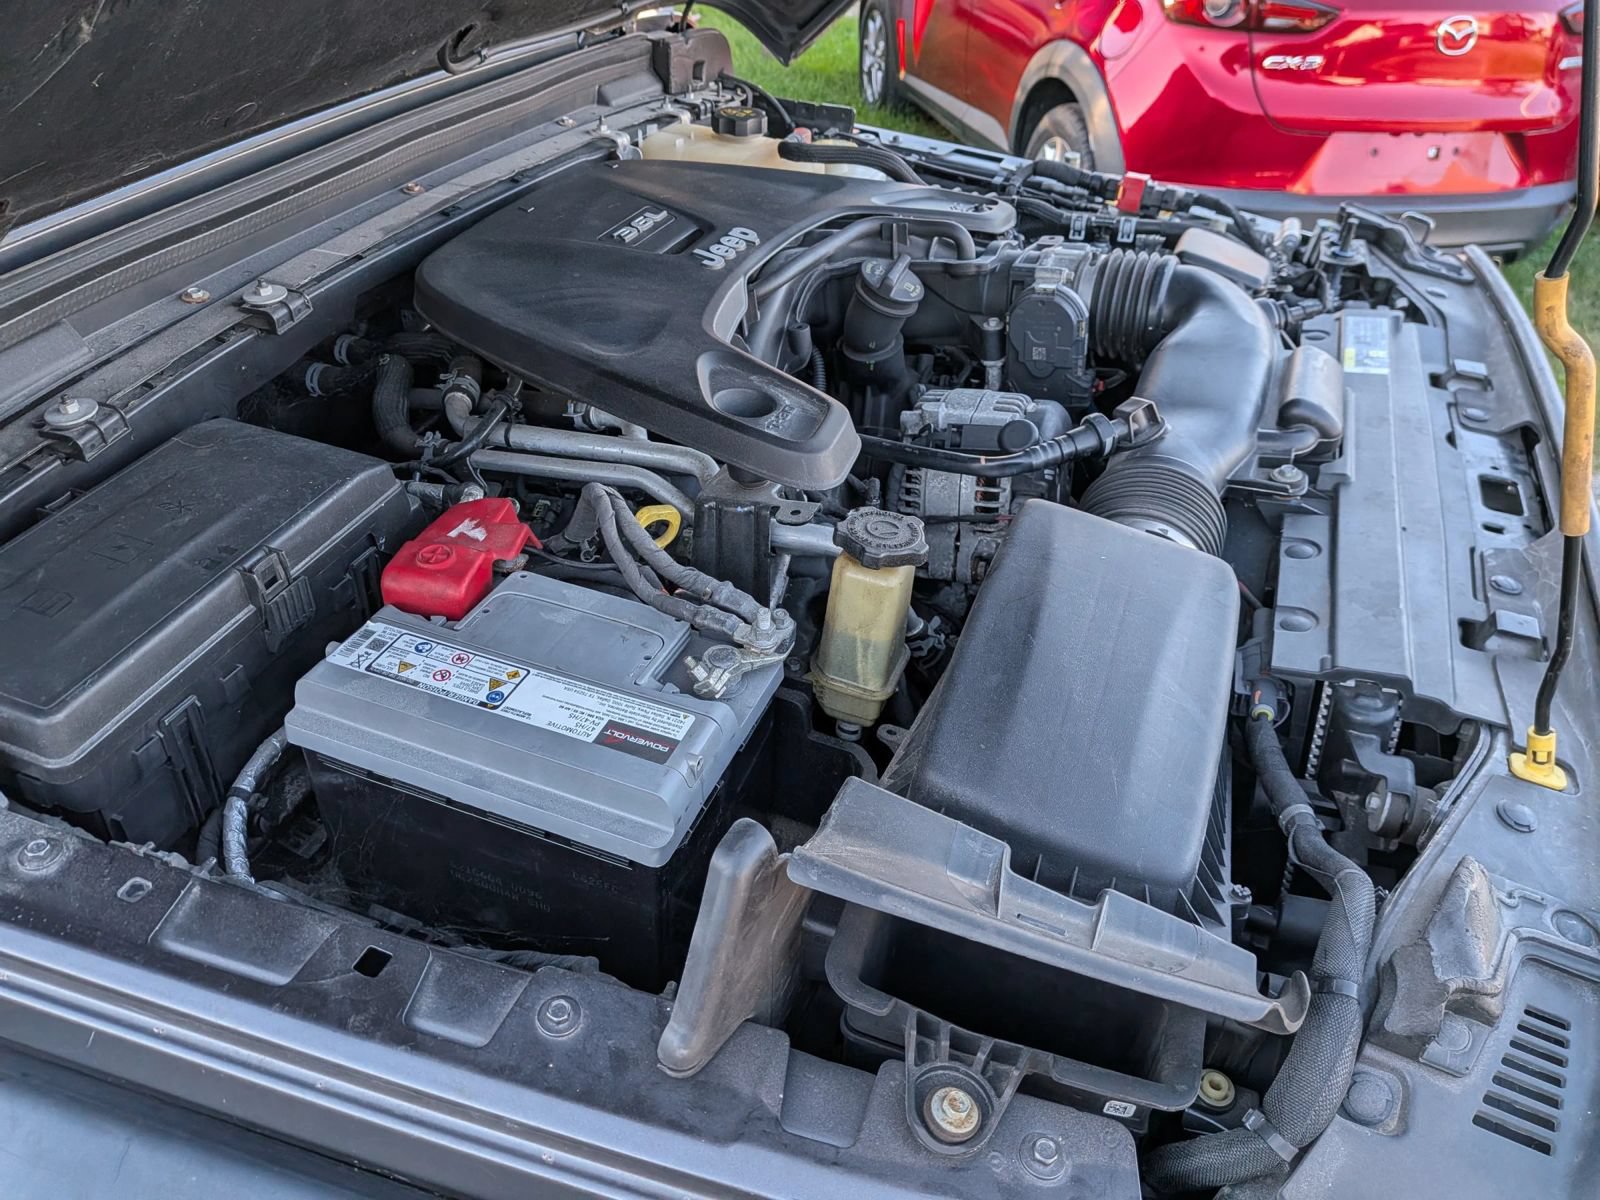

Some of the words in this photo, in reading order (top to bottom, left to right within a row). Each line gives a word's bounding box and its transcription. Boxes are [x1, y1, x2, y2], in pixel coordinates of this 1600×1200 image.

[692, 227, 760, 270] Jeep
[416, 682, 481, 704] DANGER/POISON
[545, 720, 592, 738] AUTOMOTIVE
[603, 728, 670, 752] POWERVOLT
